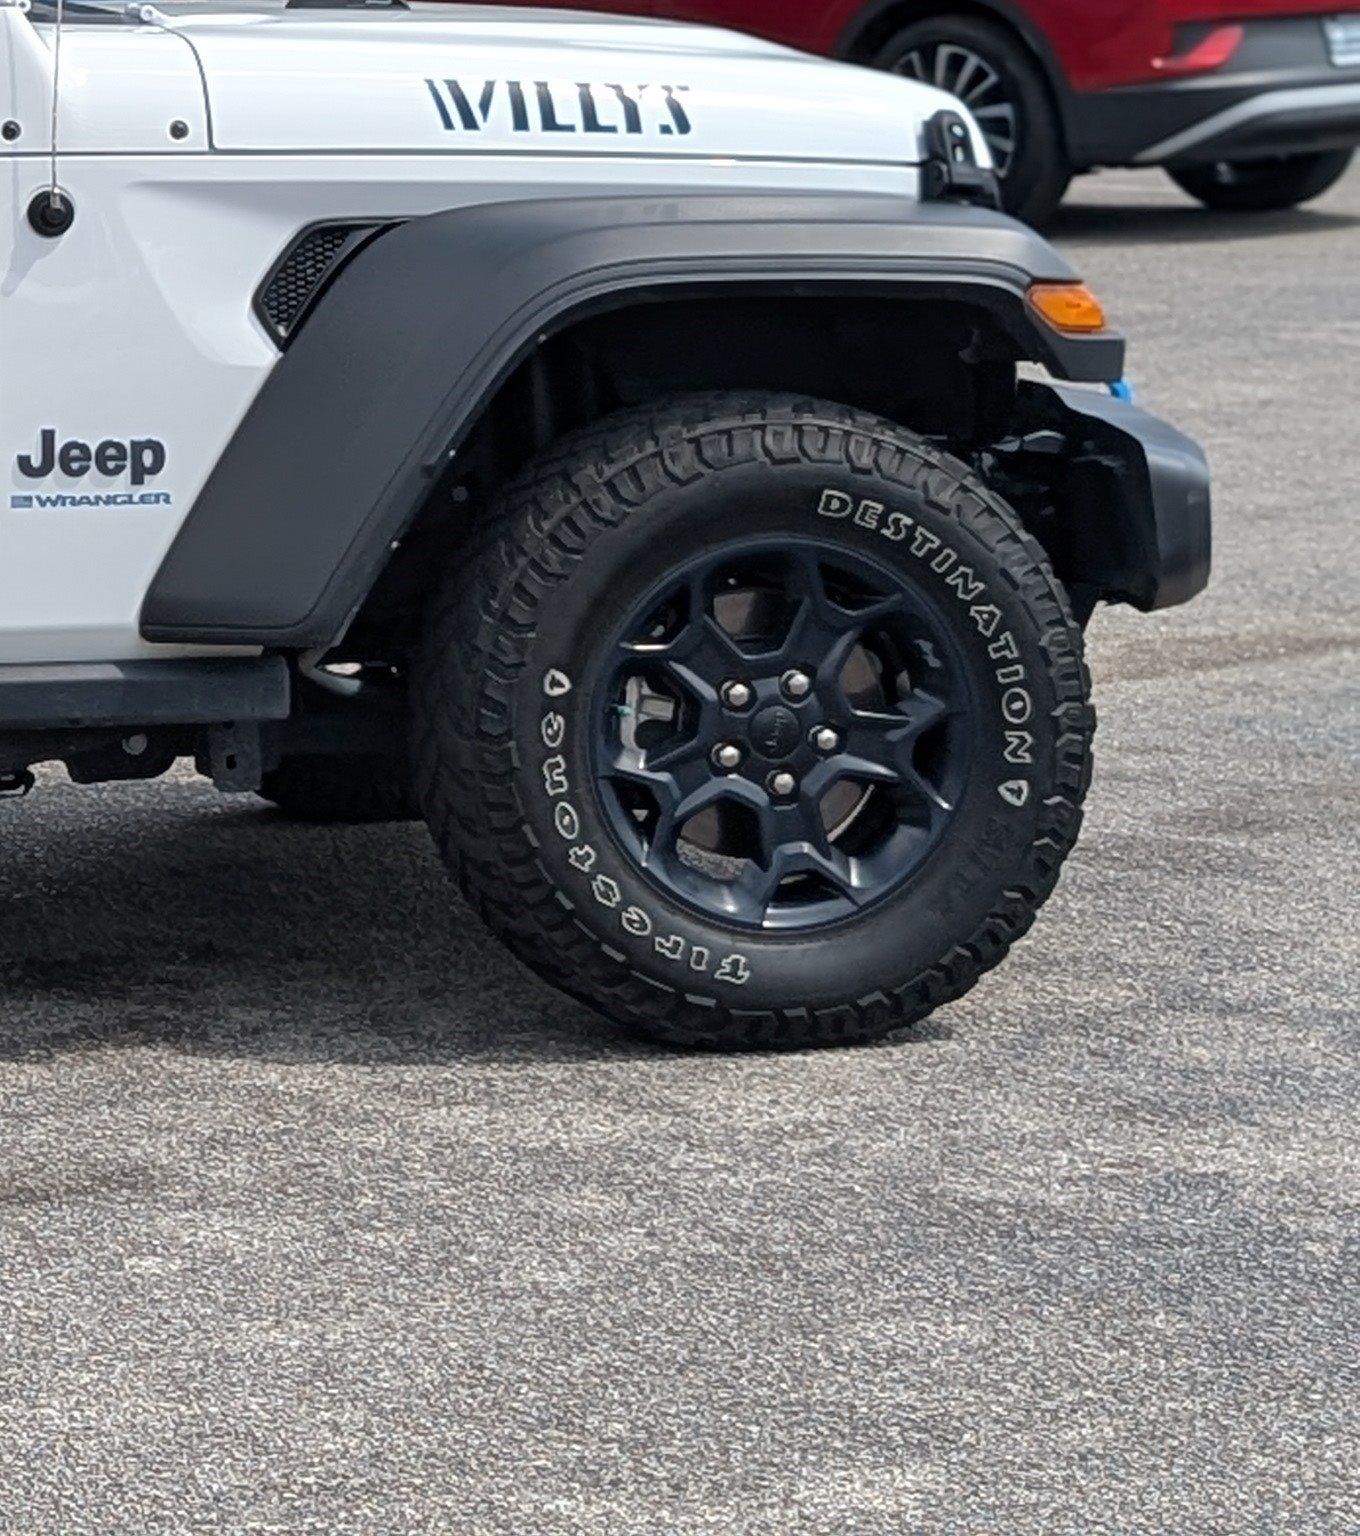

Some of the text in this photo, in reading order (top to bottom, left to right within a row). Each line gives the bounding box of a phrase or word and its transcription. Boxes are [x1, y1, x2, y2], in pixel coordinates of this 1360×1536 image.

[16, 428, 166, 486] Jeep
[35, 492, 172, 508] WRANGLER
[817, 488, 1034, 764] DESTINATION
[541, 713, 751, 985] Firestone
